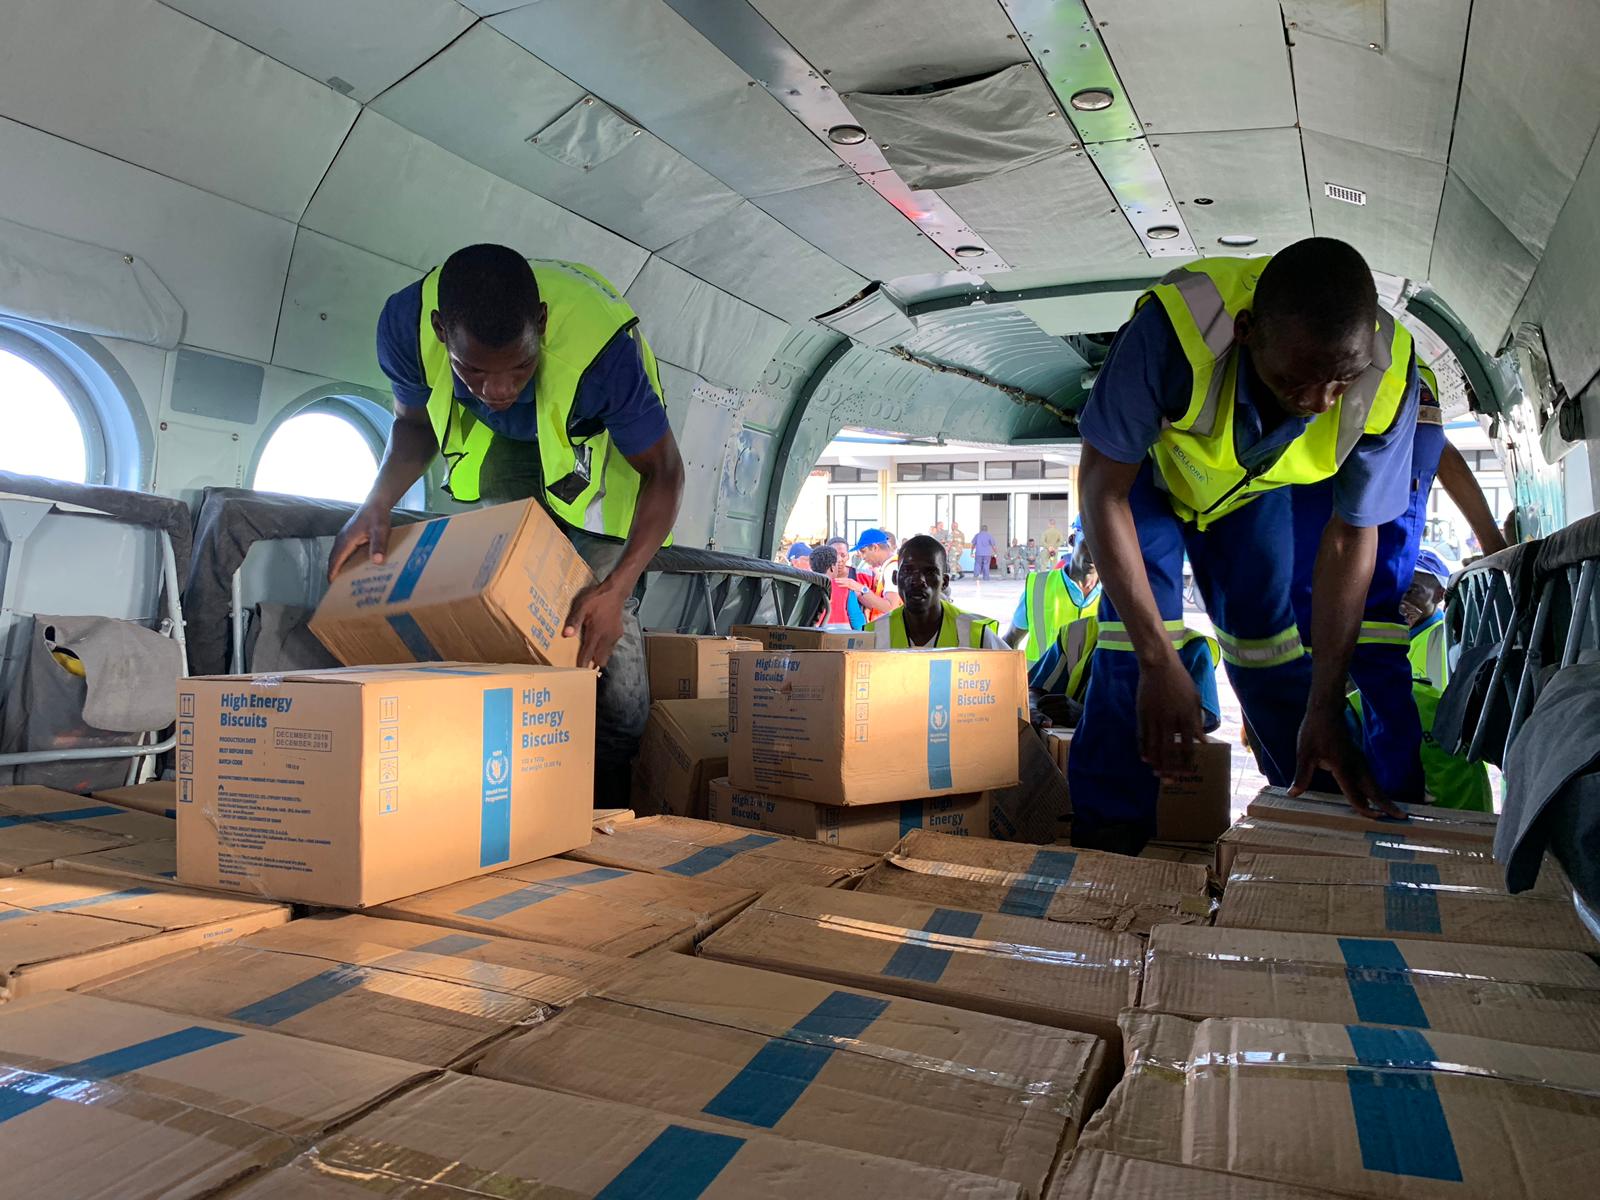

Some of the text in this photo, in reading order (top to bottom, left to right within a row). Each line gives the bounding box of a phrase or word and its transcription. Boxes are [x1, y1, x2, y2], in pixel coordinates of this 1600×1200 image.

[755, 658, 772, 671] High
[958, 660, 981, 676] High
[754, 671, 784, 682] Biscuits
[958, 678, 991, 692] Energy
[220, 693, 293, 713] High Energy
[522, 687, 551, 708] High
[957, 692, 996, 706] Biscuits
[219, 712, 268, 728] Biscuits
[521, 710, 565, 727] Energy
[276, 730, 312, 739] DECEMBER
[521, 728, 570, 749] Biscuits
[276, 739, 313, 747] DECEMBER
[731, 793, 748, 806] High
[731, 807, 761, 820] Biscuits
[929, 813, 964, 827] Energy
